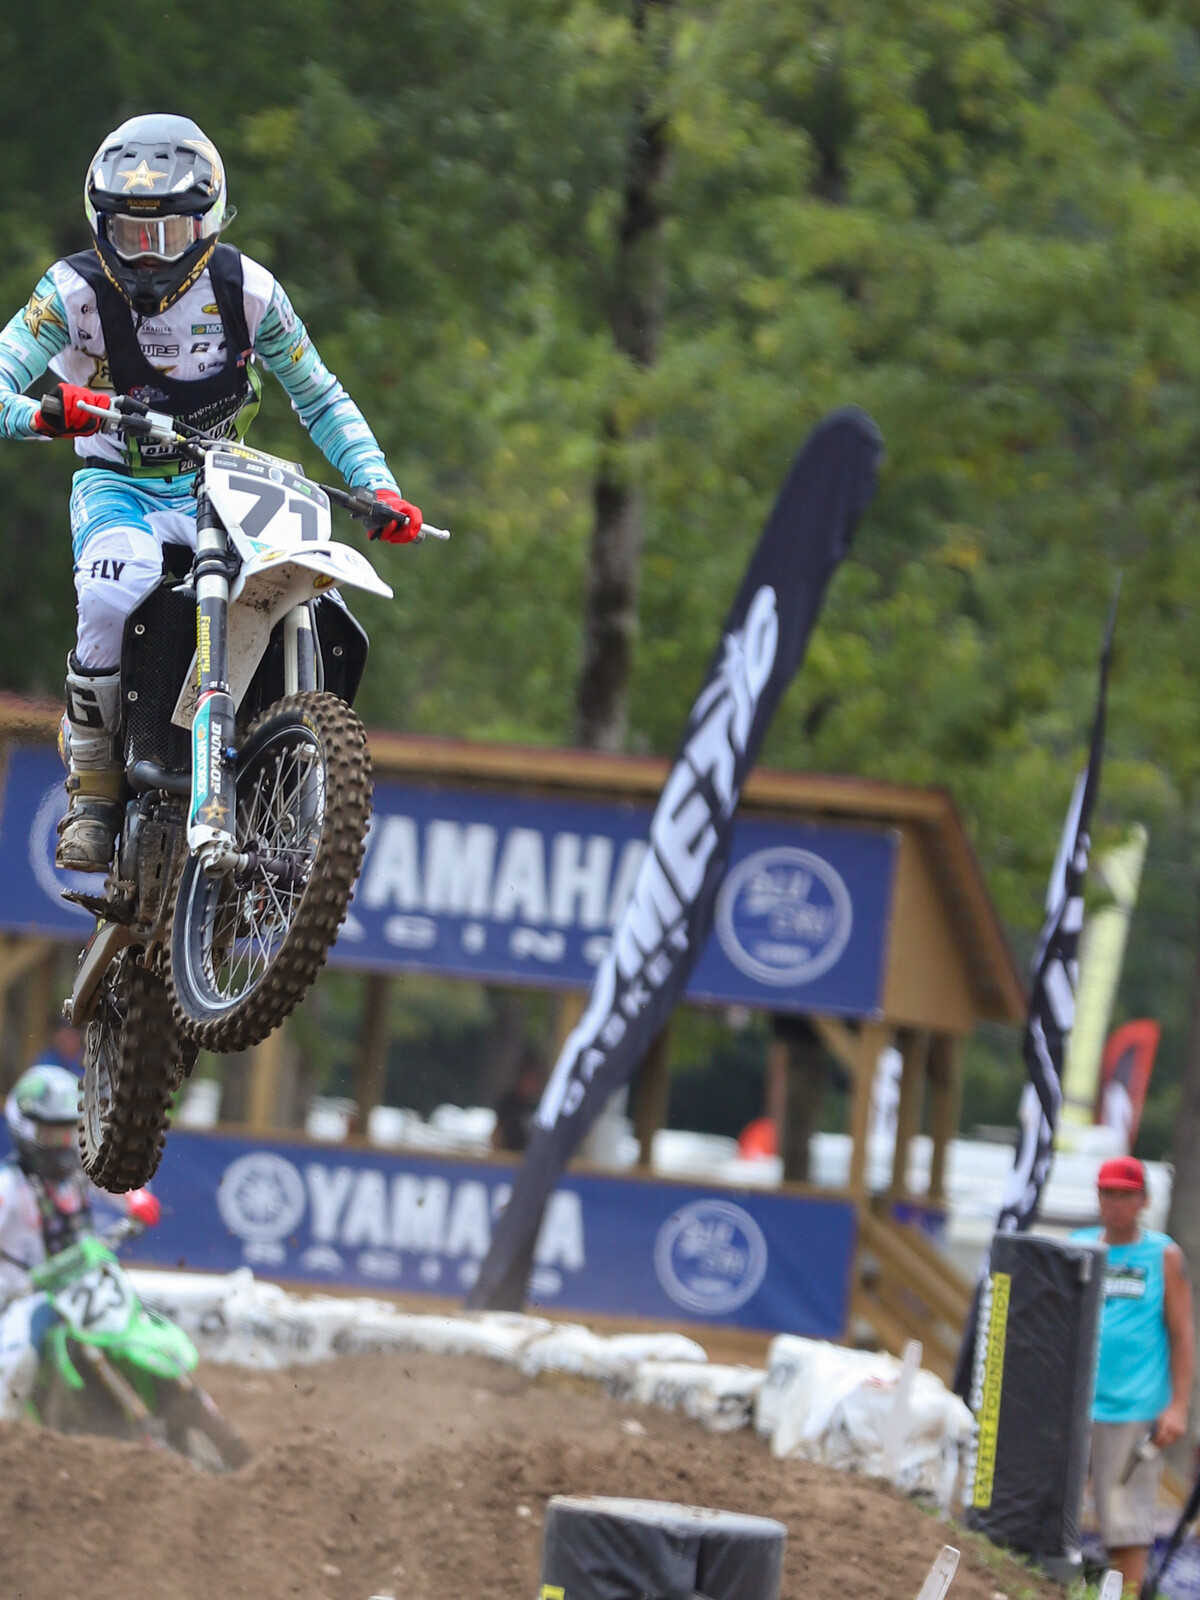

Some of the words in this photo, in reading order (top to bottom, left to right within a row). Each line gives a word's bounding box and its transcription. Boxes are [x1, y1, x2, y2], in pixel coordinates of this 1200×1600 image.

[140, 344, 180, 357] WPS
[229, 474, 319, 541] 71
[90, 559, 127, 582] FLY
[200, 615, 211, 673] Factory
[196, 738, 208, 798] MOTOREX
[211, 720, 222, 795] DUNLOP
[305, 1163, 586, 1272] YAMAA
[984, 1275, 1010, 1420] FOUNDATION
[976, 1427, 996, 1501] SAFETY
